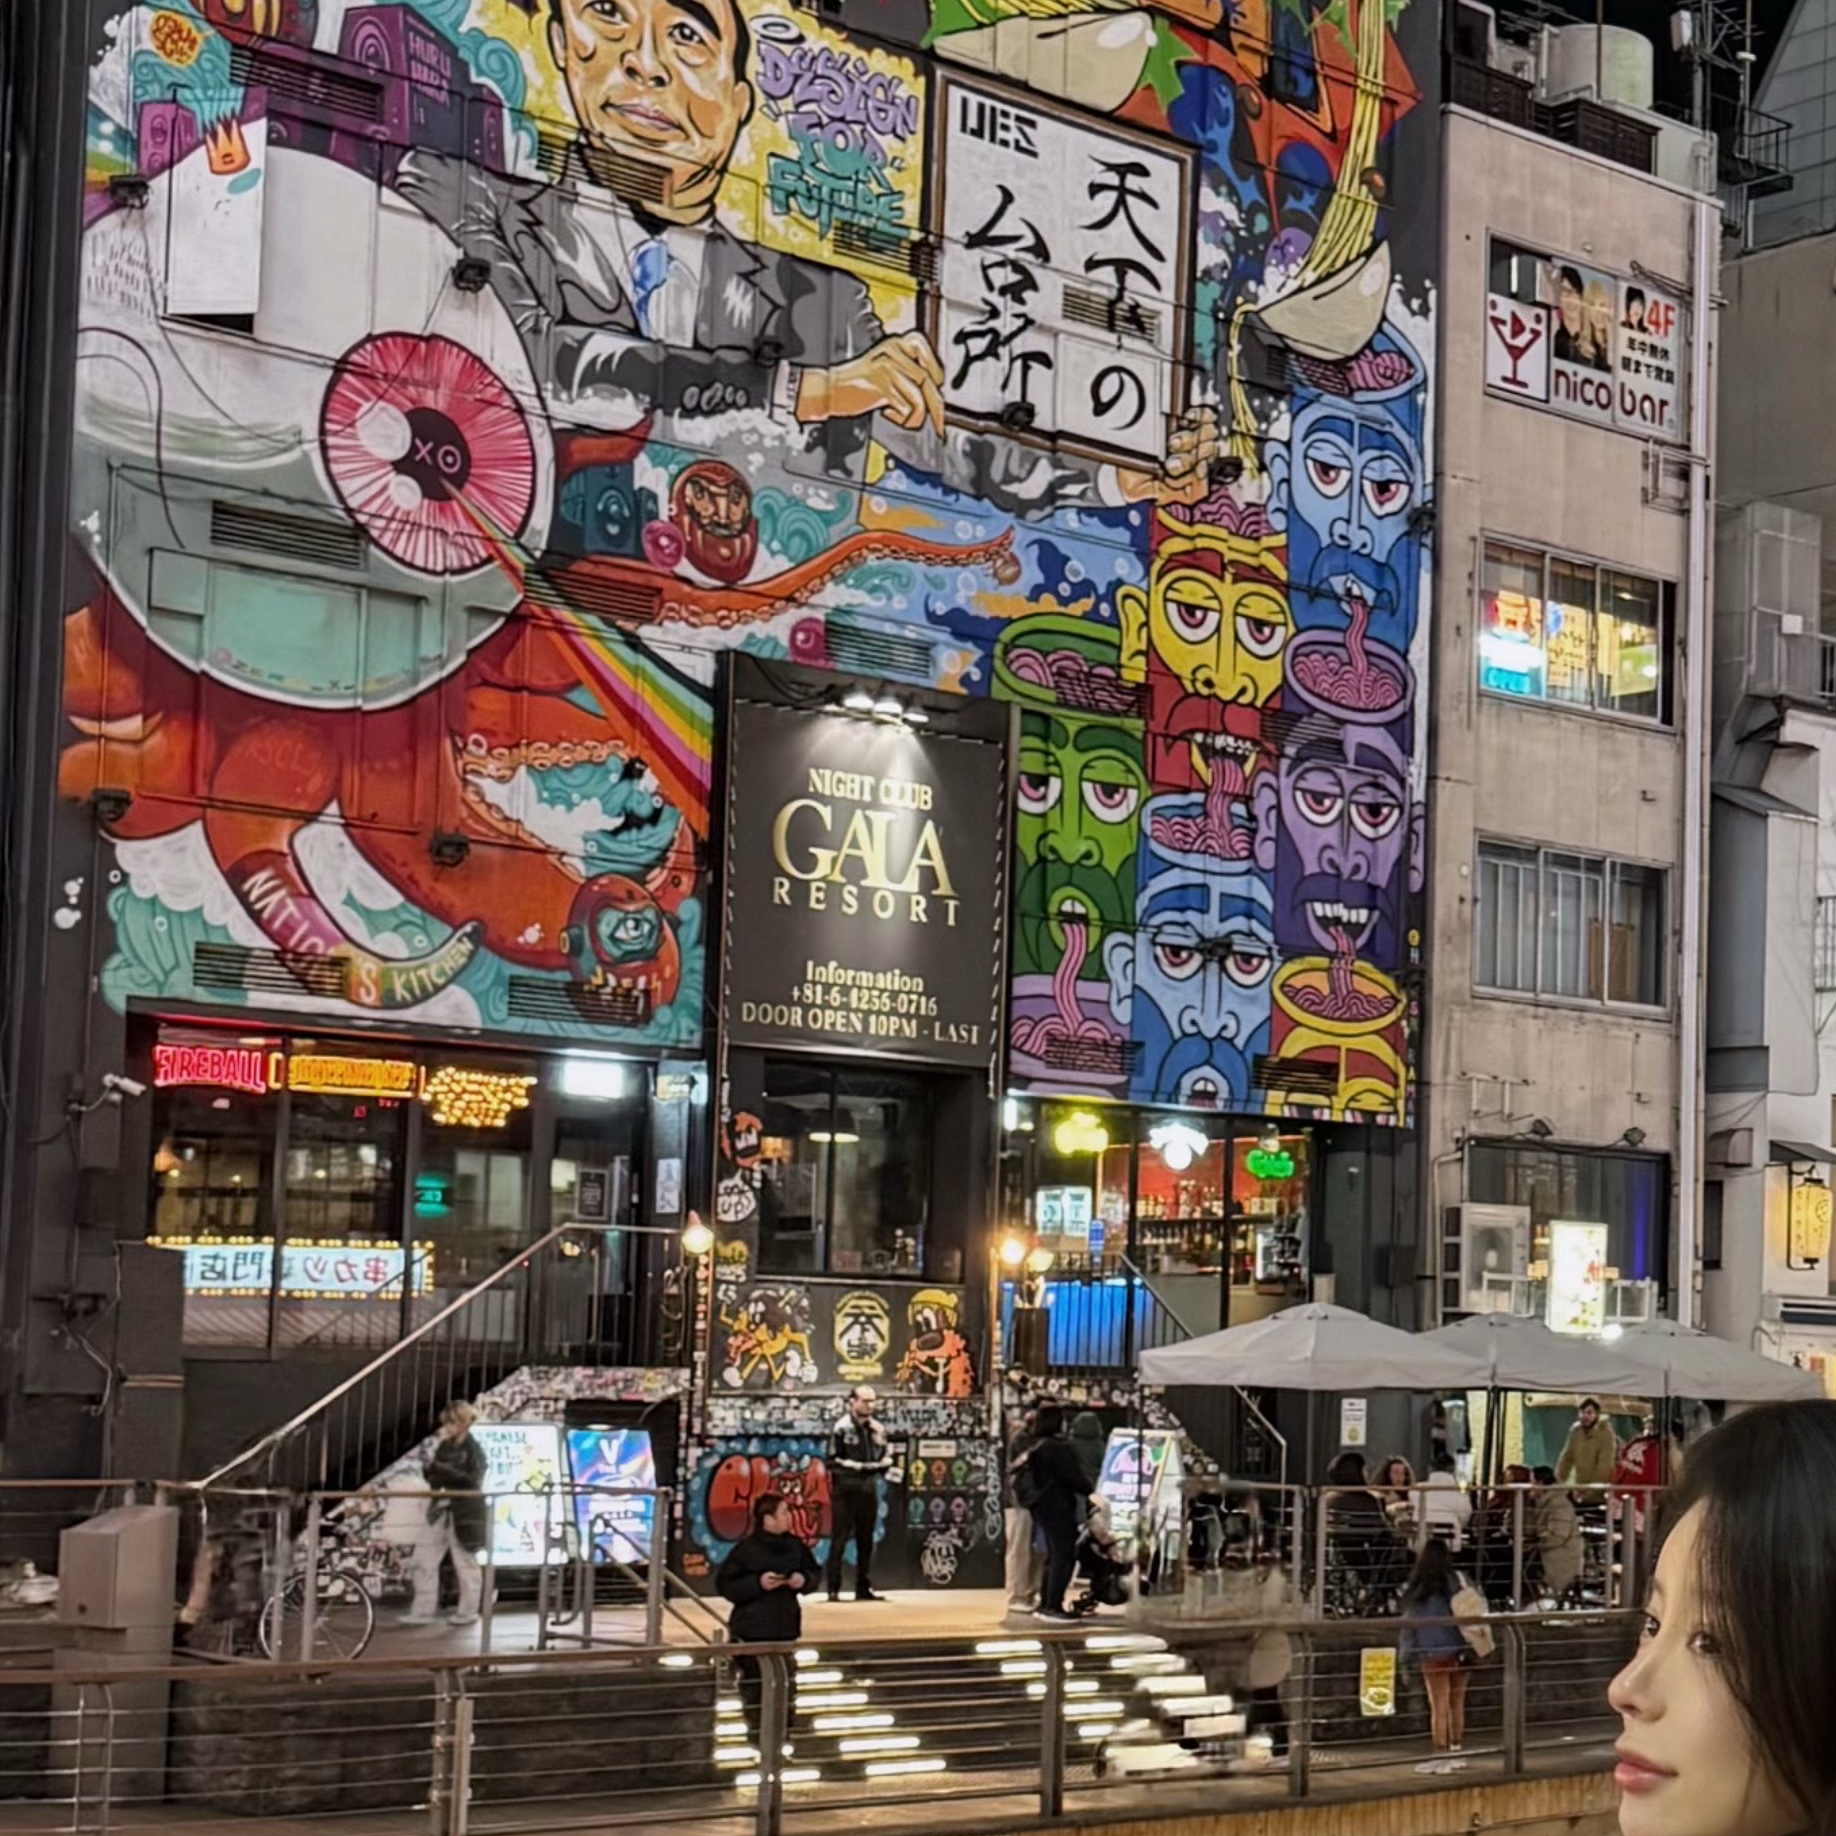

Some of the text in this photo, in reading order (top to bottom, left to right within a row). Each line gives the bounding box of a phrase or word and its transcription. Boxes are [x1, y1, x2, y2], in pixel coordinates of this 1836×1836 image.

[951, 184, 1053, 401] 台所
[1079, 154, 1167, 431] 天下の
[1647, 300, 1676, 337] 4F
[1554, 369, 1612, 411] nico
[808, 767, 933, 810] NIGHT CLUB
[773, 799, 960, 898] GALA
[773, 876, 960, 927] RESORT
[394, 937, 473, 1003] KITCHEN
[806, 960, 924, 992] Information
[742, 1002, 803, 1028] DOOR
[808, 1010, 863, 1033] OPEN
[868, 1014, 918, 1039] 10PM
[934, 1021, 980, 1045] LAST
[153, 1045, 267, 1094] FIREBALL
